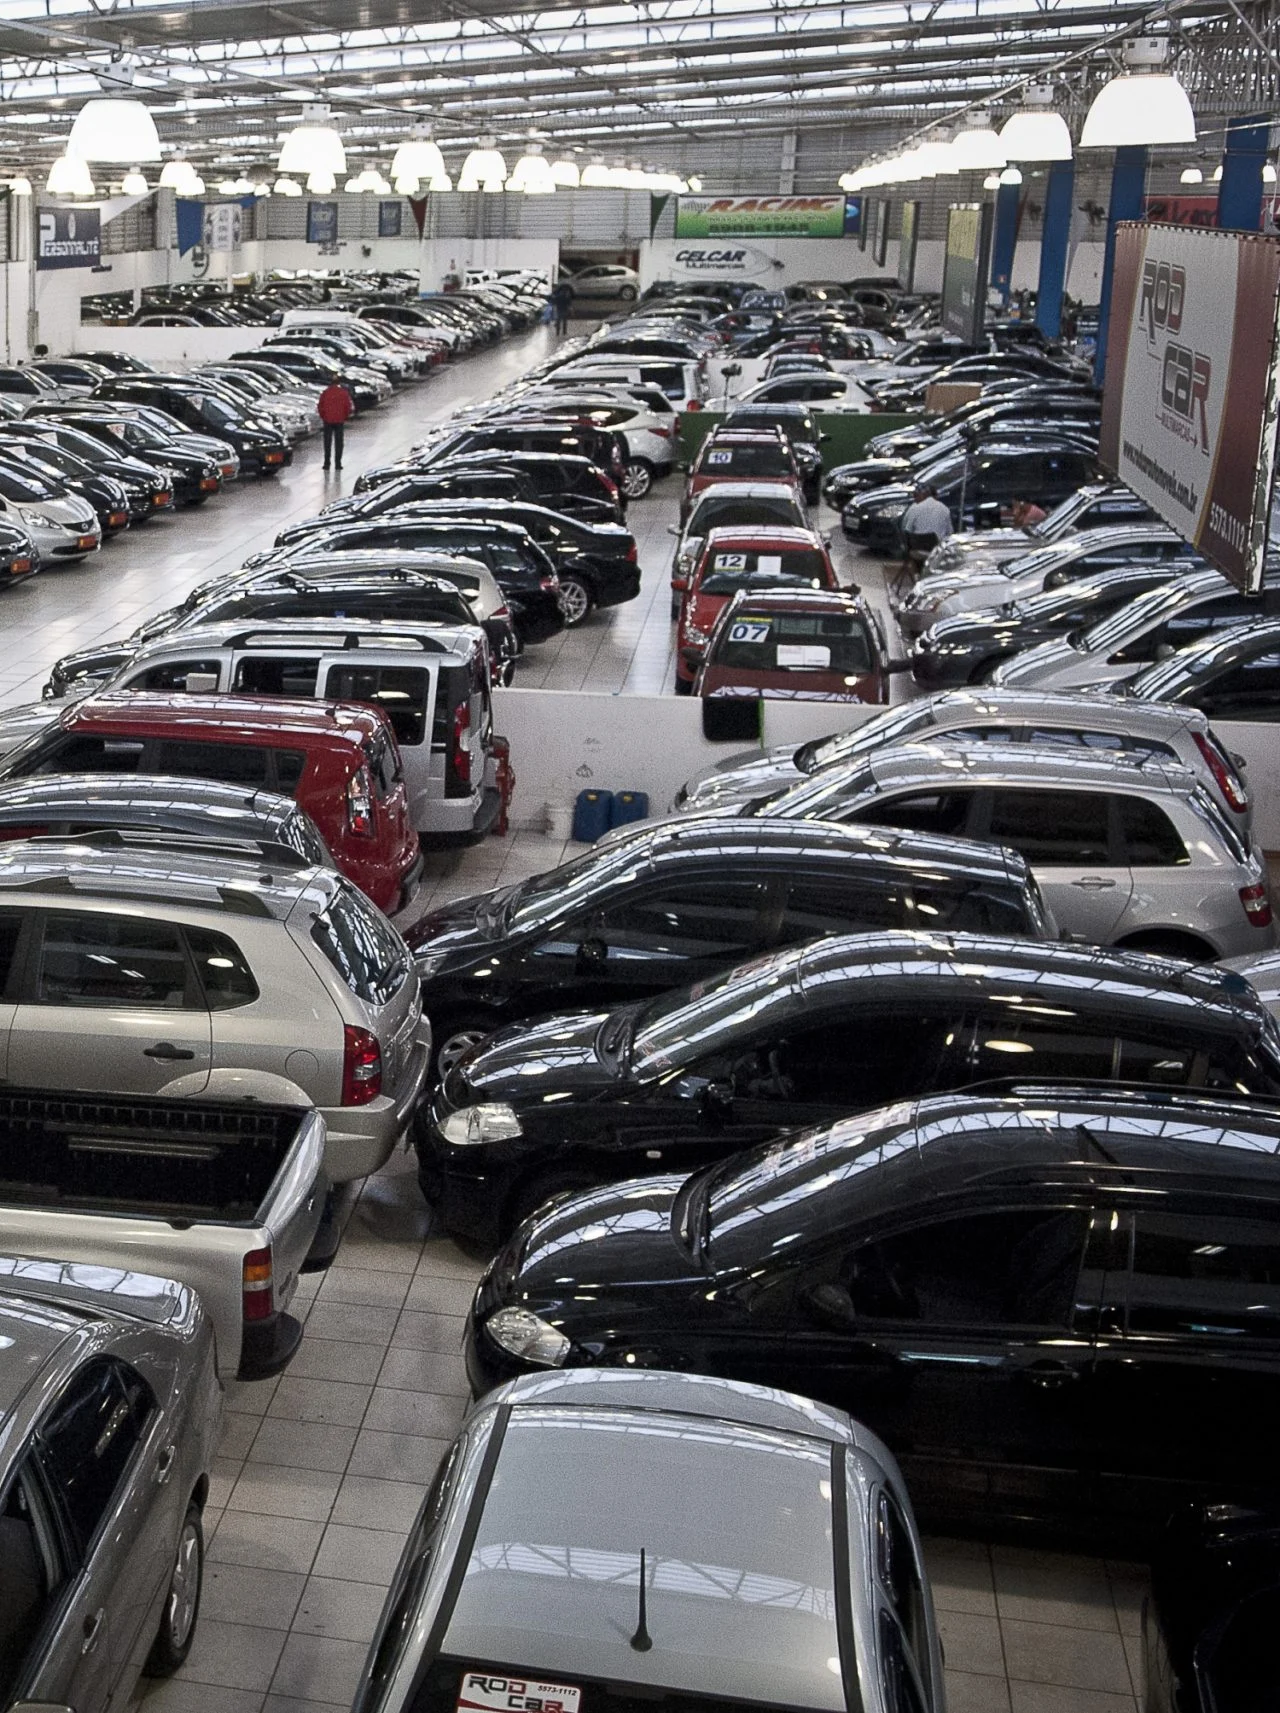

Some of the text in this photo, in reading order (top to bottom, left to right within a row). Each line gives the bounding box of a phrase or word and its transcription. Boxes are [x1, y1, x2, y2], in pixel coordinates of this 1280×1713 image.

[706, 198, 841, 213] RACING
[676, 250, 747, 263] CELCAR
[719, 556, 742, 568] 12
[732, 624, 768, 640] 07
[537, 1685, 577, 1696] 5573-1112
